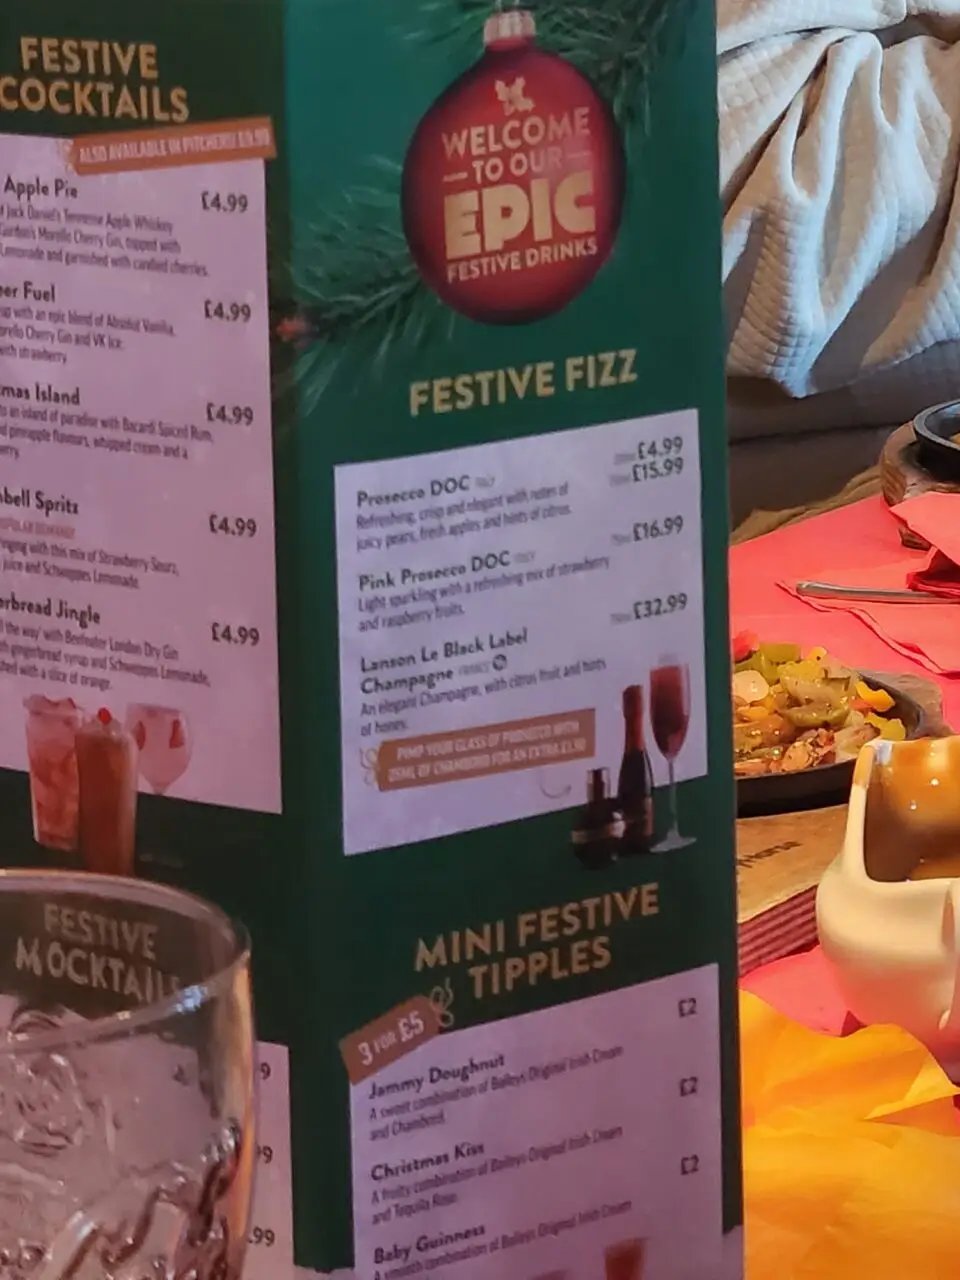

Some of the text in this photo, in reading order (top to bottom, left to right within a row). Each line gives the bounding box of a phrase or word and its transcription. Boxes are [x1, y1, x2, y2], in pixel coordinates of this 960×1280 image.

[20, 36, 158, 80] FESTIVE
[0, 76, 189, 123] COCKTAILS
[441, 107, 591, 159] WELCOME
[471, 145, 563, 184] TO OUR
[4, 175, 78, 202] Apple Pie
[201, 190, 248, 213] £4.99
[443, 170, 596, 261] EPIC
[446, 237, 598, 284] FESTIVE DRINKS
[24, 281, 55, 303] Fuel
[204, 300, 251, 323] £4.99
[35, 382, 80, 406] Island
[408, 348, 638, 417] FESTIVE FIZZ
[206, 402, 254, 426] £4.99
[638, 435, 684, 460] £4.99
[632, 456, 684, 483] £15.99
[35, 489, 79, 517] Spritz
[356, 487, 425, 508] Prosecco
[430, 474, 470, 497] DOC
[209, 514, 257, 538] £4.99
[632, 515, 684, 541] £16.99
[358, 571, 396, 592] Pink
[401, 563, 467, 586] Prosecco
[470, 550, 511, 574] DOC
[56, 599, 100, 629] Jingle
[633, 592, 688, 621] £32.99
[211, 622, 260, 646] £4.99
[360, 627, 528, 673] Lanson Le Black Label
[360, 668, 454, 696] Champagne
[43, 903, 160, 961] FESTIVE
[413, 882, 660, 972] MINI FESTIVE
[468, 935, 613, 1001] TIPPLES
[678, 997, 698, 1018] £2
[358, 1041, 374, 1066] 3
[398, 1010, 424, 1042] £5
[368, 1054, 505, 1100] Jammy Doughnut
[678, 1076, 698, 1097] £2
[370, 1142, 485, 1182] Christmas Kiss
[680, 1155, 700, 1176] £2
[373, 1224, 486, 1265] Baby Guinness
